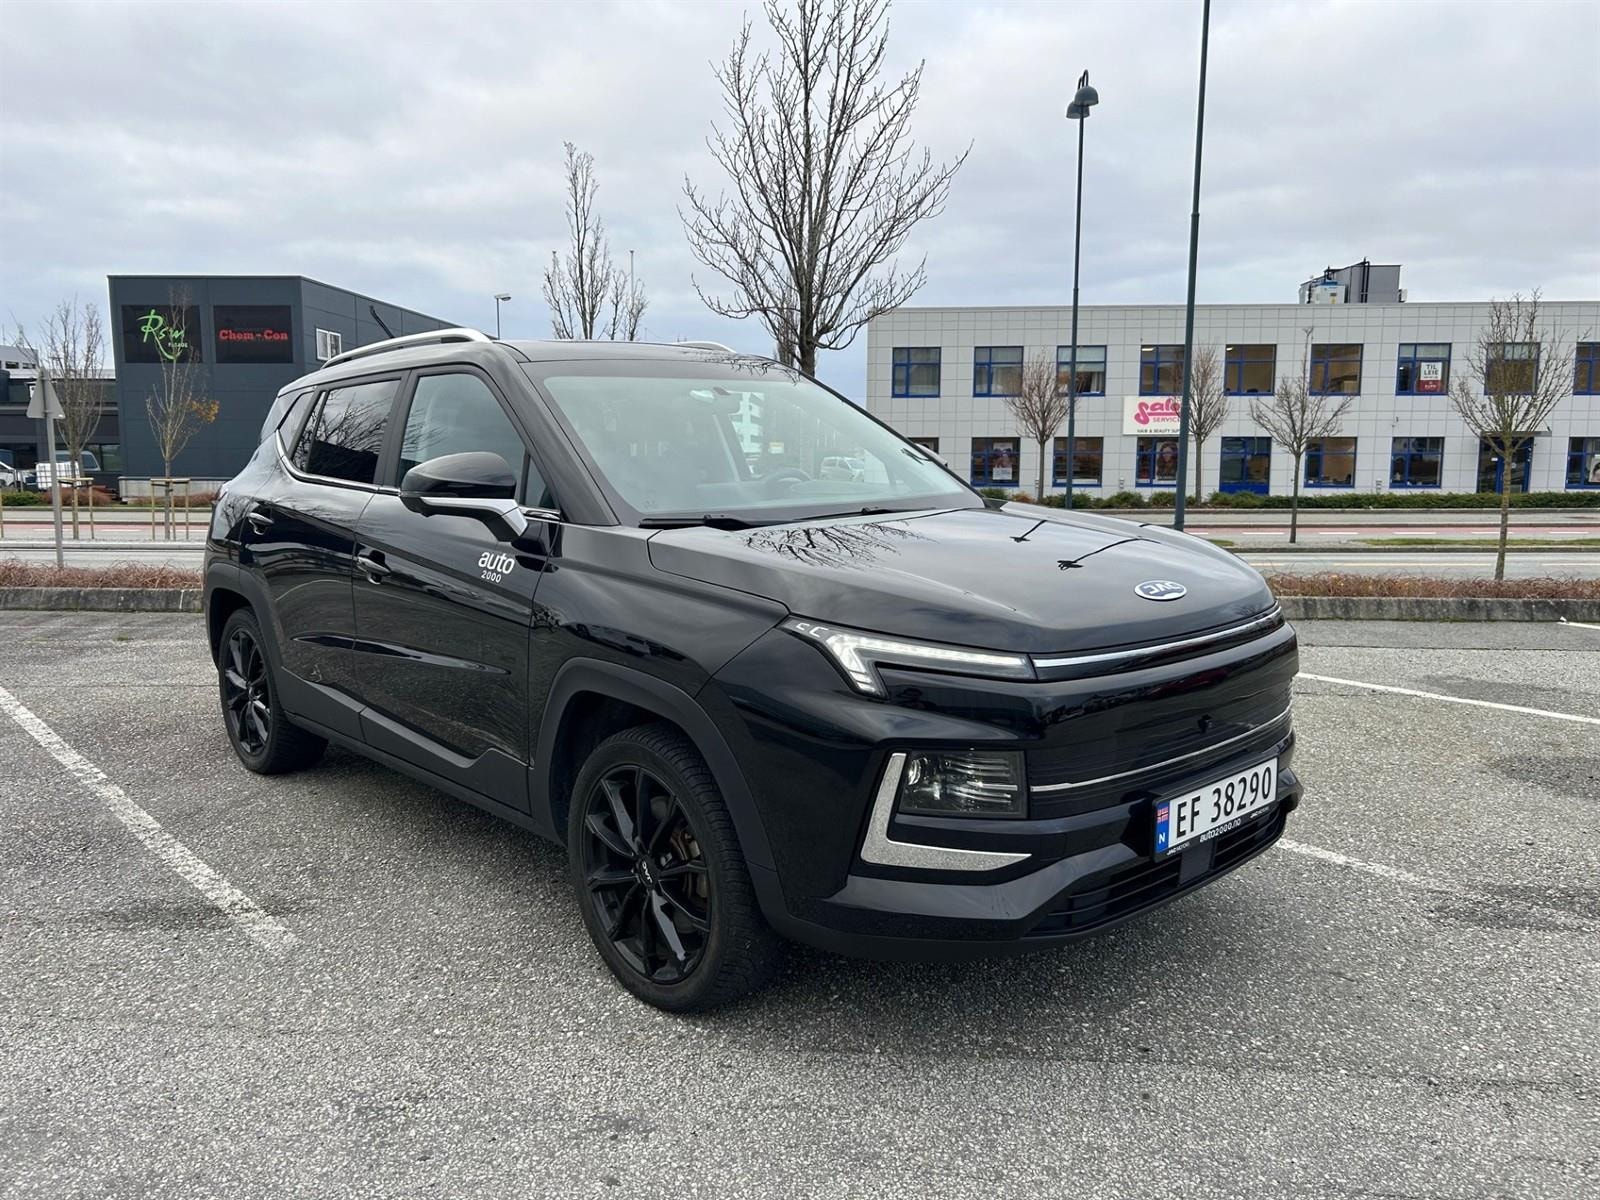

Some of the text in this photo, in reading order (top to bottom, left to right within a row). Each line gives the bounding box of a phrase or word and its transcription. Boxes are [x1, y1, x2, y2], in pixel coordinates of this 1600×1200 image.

[1134, 398, 1181, 425] Salo
[478, 552, 515, 574] auto
[481, 570, 502, 583] 2000
[1176, 766, 1272, 839] EF 38290
[1158, 832, 1166, 845] N
[1200, 818, 1241, 842] auto2000.no
